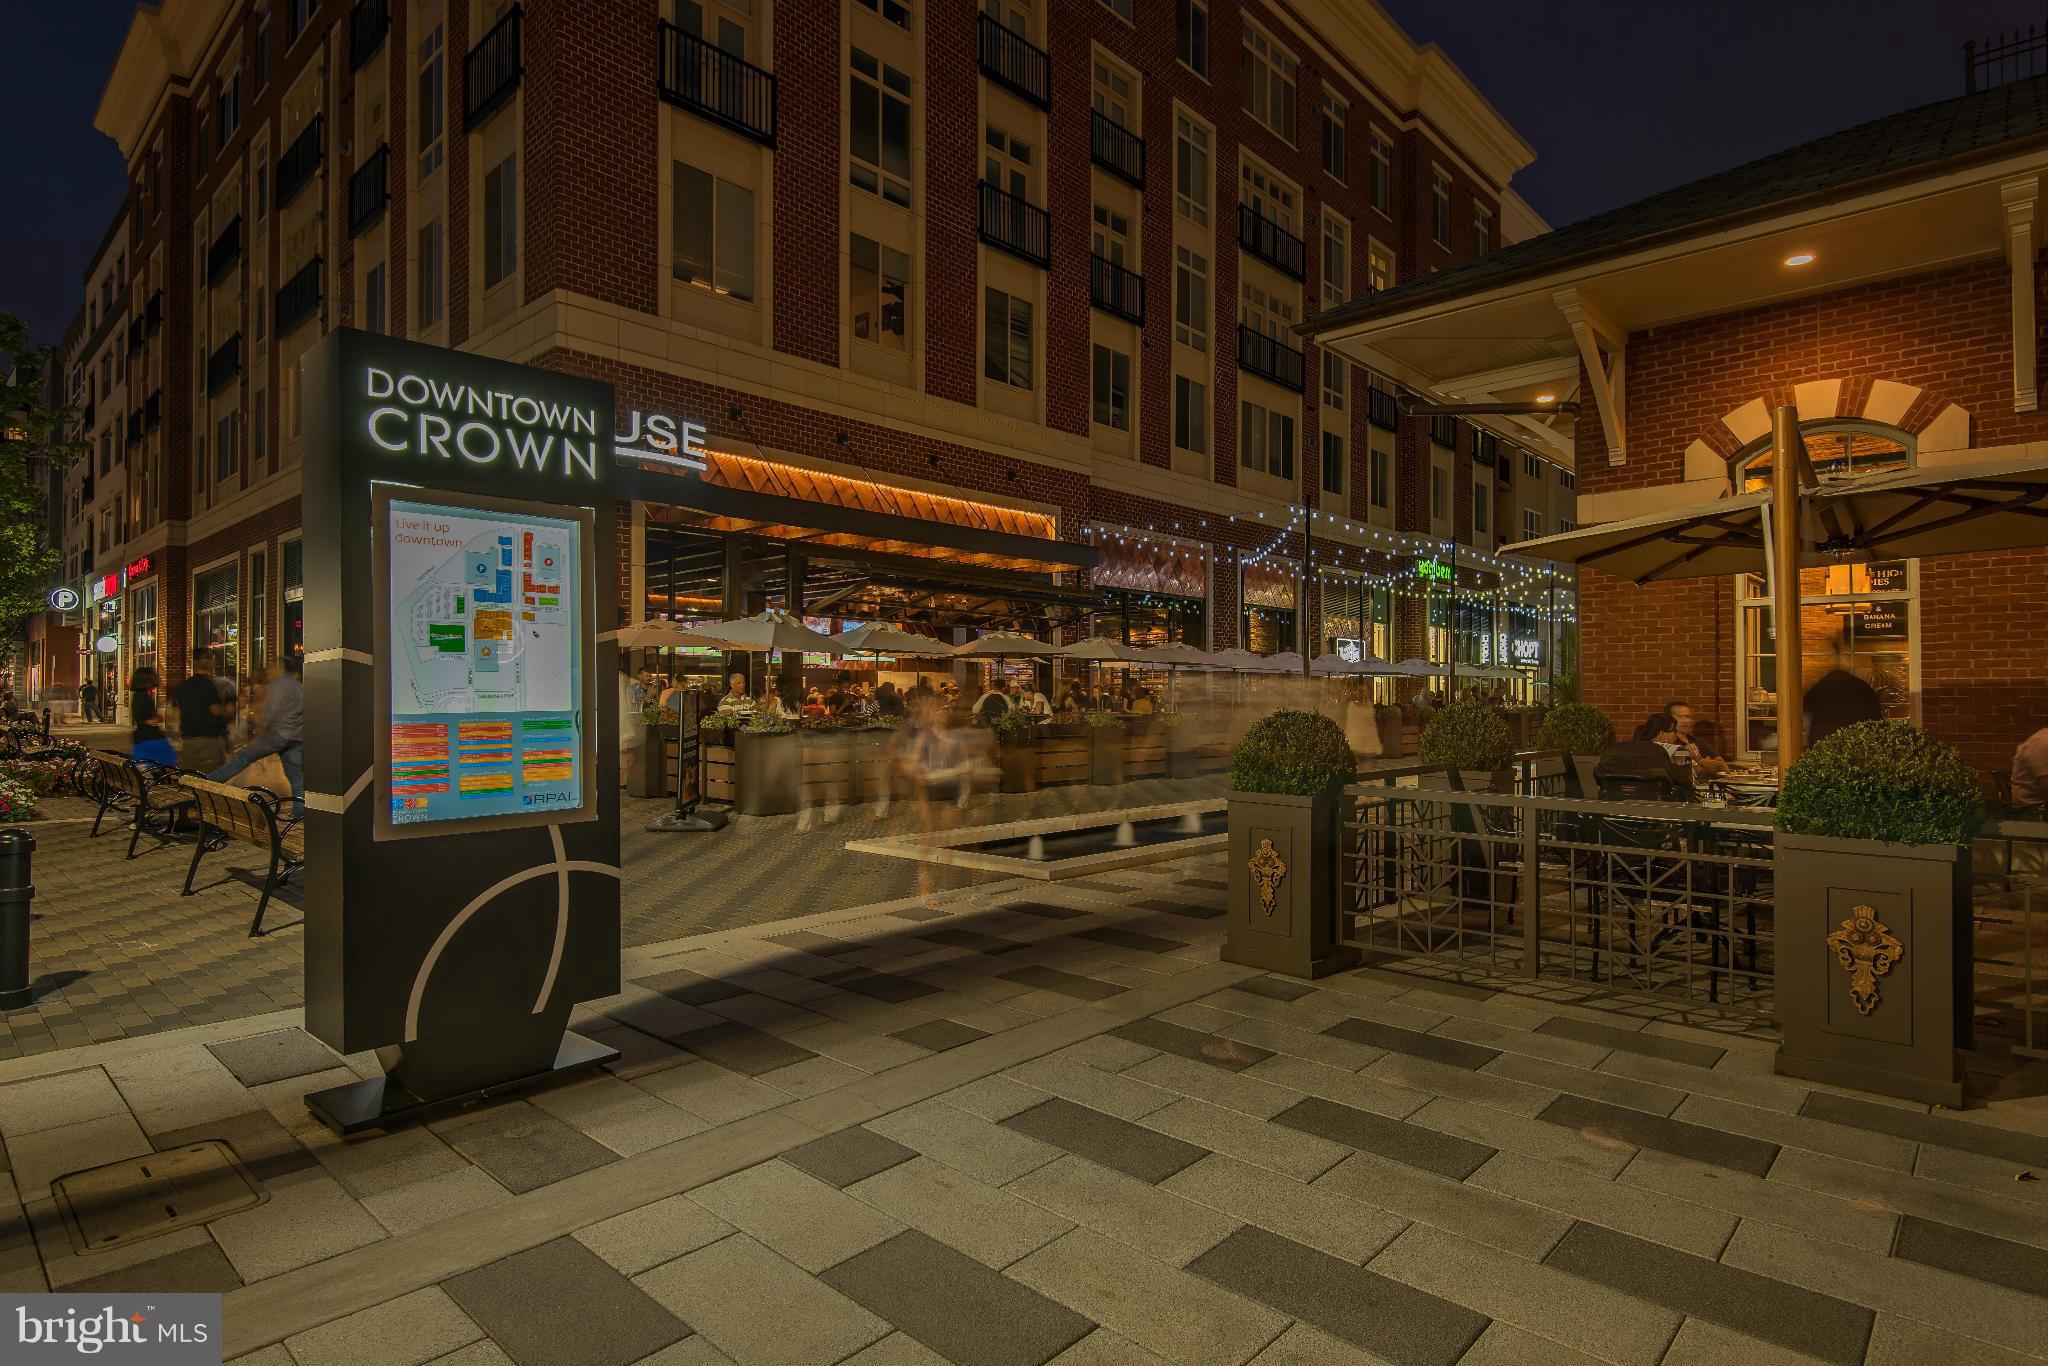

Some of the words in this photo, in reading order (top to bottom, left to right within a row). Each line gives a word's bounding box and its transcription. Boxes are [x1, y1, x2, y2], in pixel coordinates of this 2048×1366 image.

[367, 366, 596, 436] DOWNTOWN
[367, 406, 596, 480] CROWN
[395, 518, 419, 530] Live
[423, 519, 432, 531] it
[434, 523, 450, 535] up
[395, 532, 464, 548] downtown
[58, 591, 74, 608] P
[534, 791, 572, 805] RPAI
